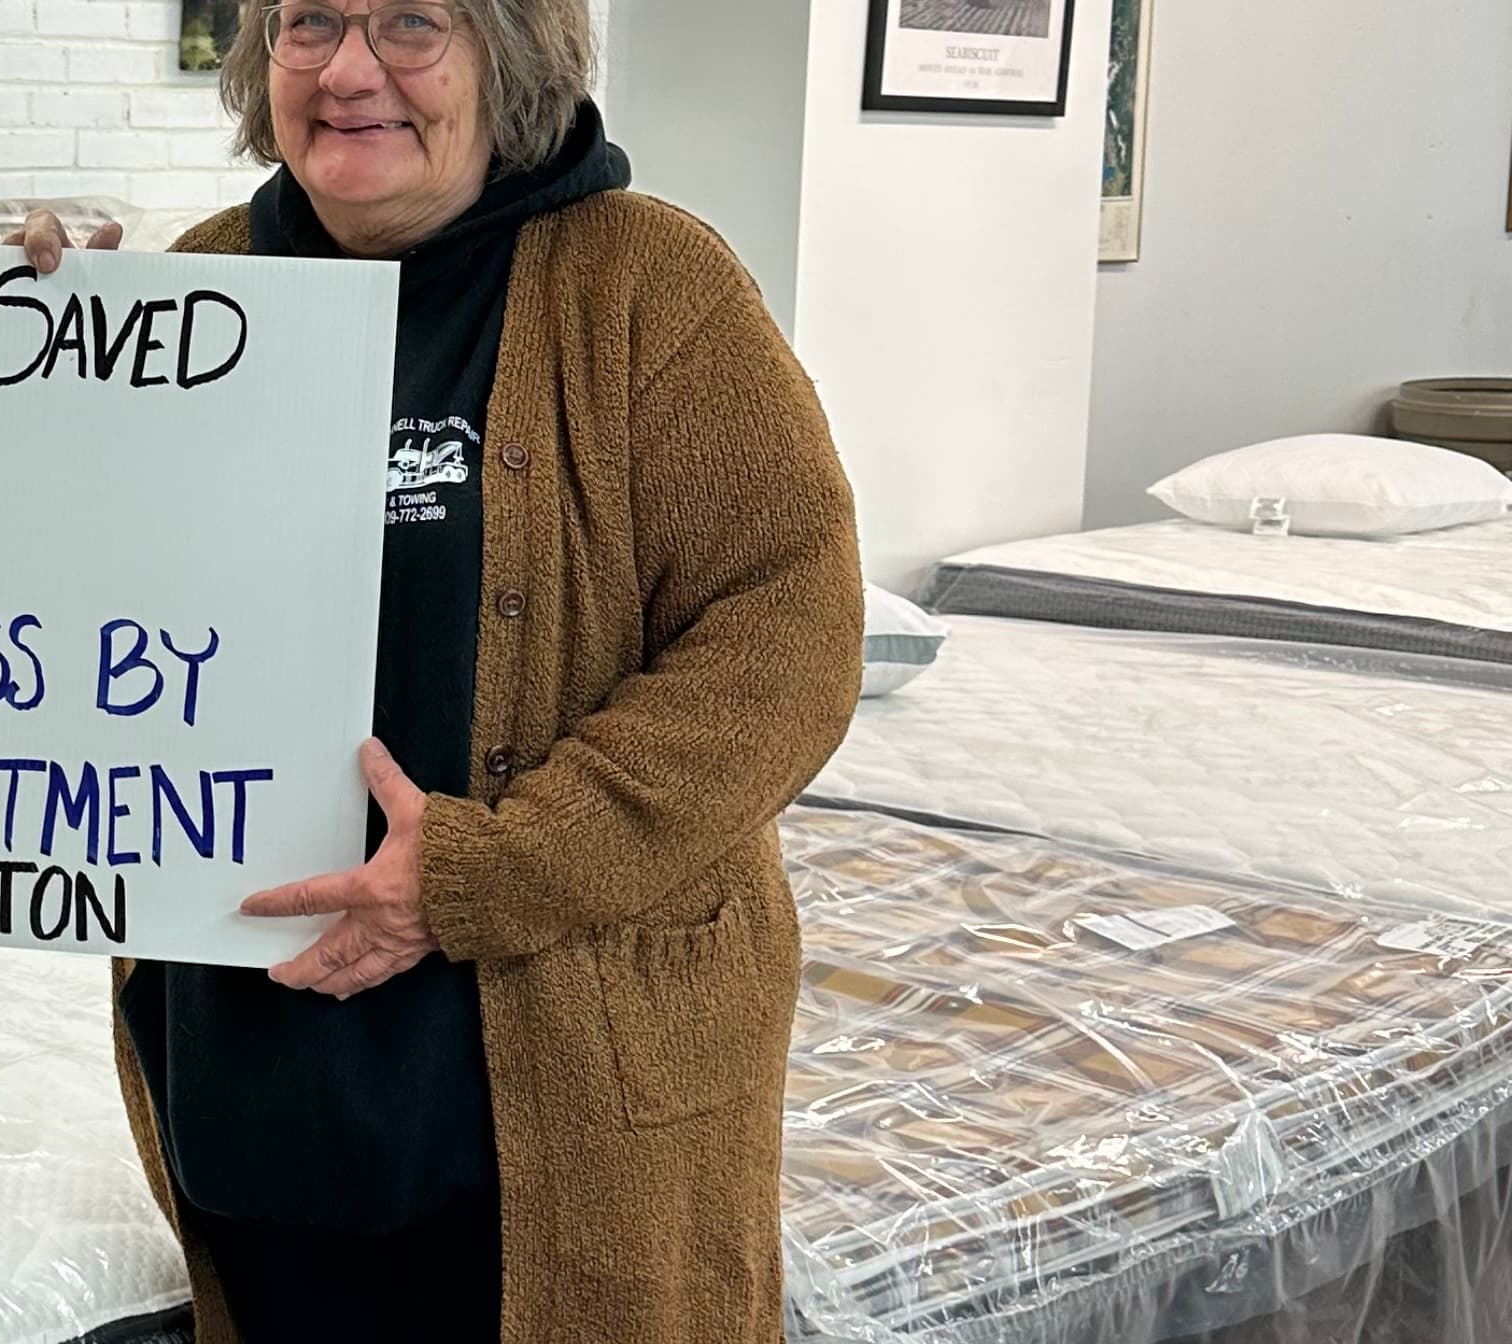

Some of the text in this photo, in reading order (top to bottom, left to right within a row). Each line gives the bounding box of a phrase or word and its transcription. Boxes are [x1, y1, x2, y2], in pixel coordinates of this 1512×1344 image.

[418, 418, 448, 433] TRUCK
[448, 415, 481, 445] REPAIR
[389, 491, 437, 507] & TOWING
[97, 619, 220, 727] BY
